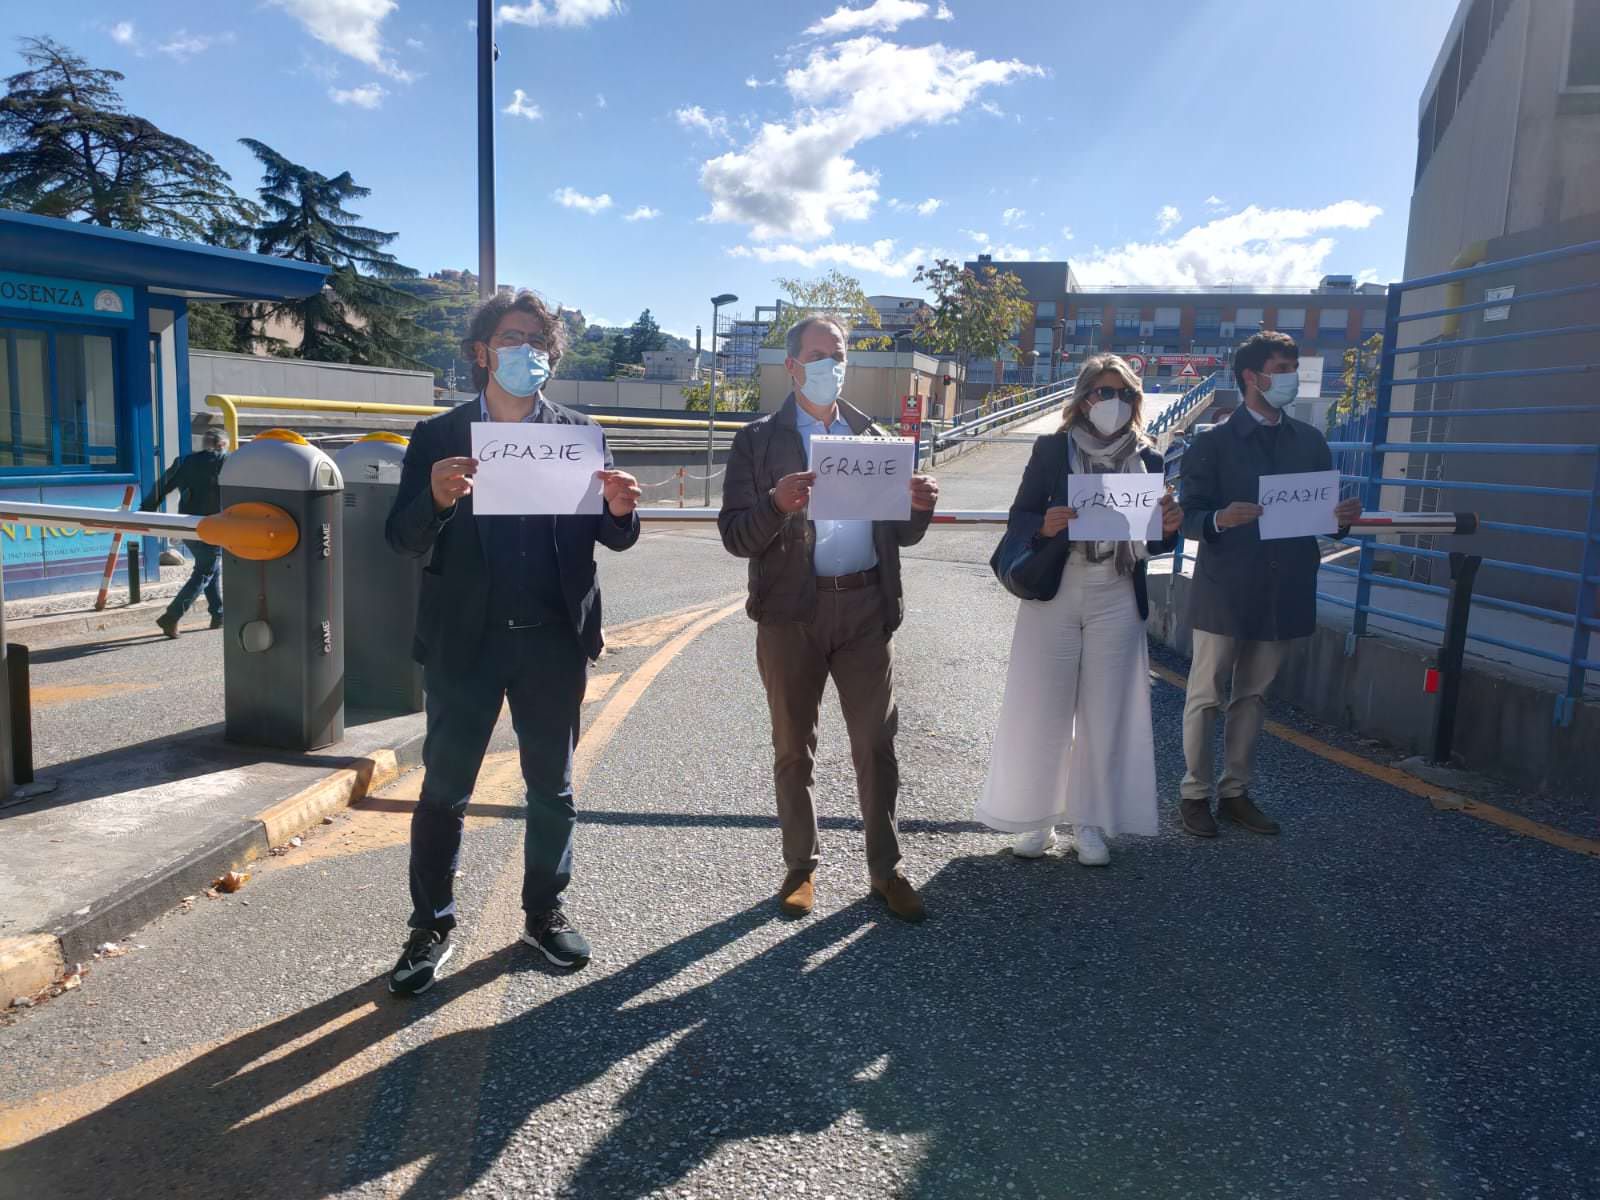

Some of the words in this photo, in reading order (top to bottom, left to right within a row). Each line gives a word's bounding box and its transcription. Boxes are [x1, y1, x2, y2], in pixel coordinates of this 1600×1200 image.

[0, 281, 85, 308] OSENZA
[478, 439, 585, 462] GRAZIE
[819, 456, 897, 476] GRAZIE
[1071, 489, 1155, 511] GRAZIE
[1261, 486, 1334, 506] GRAZIE
